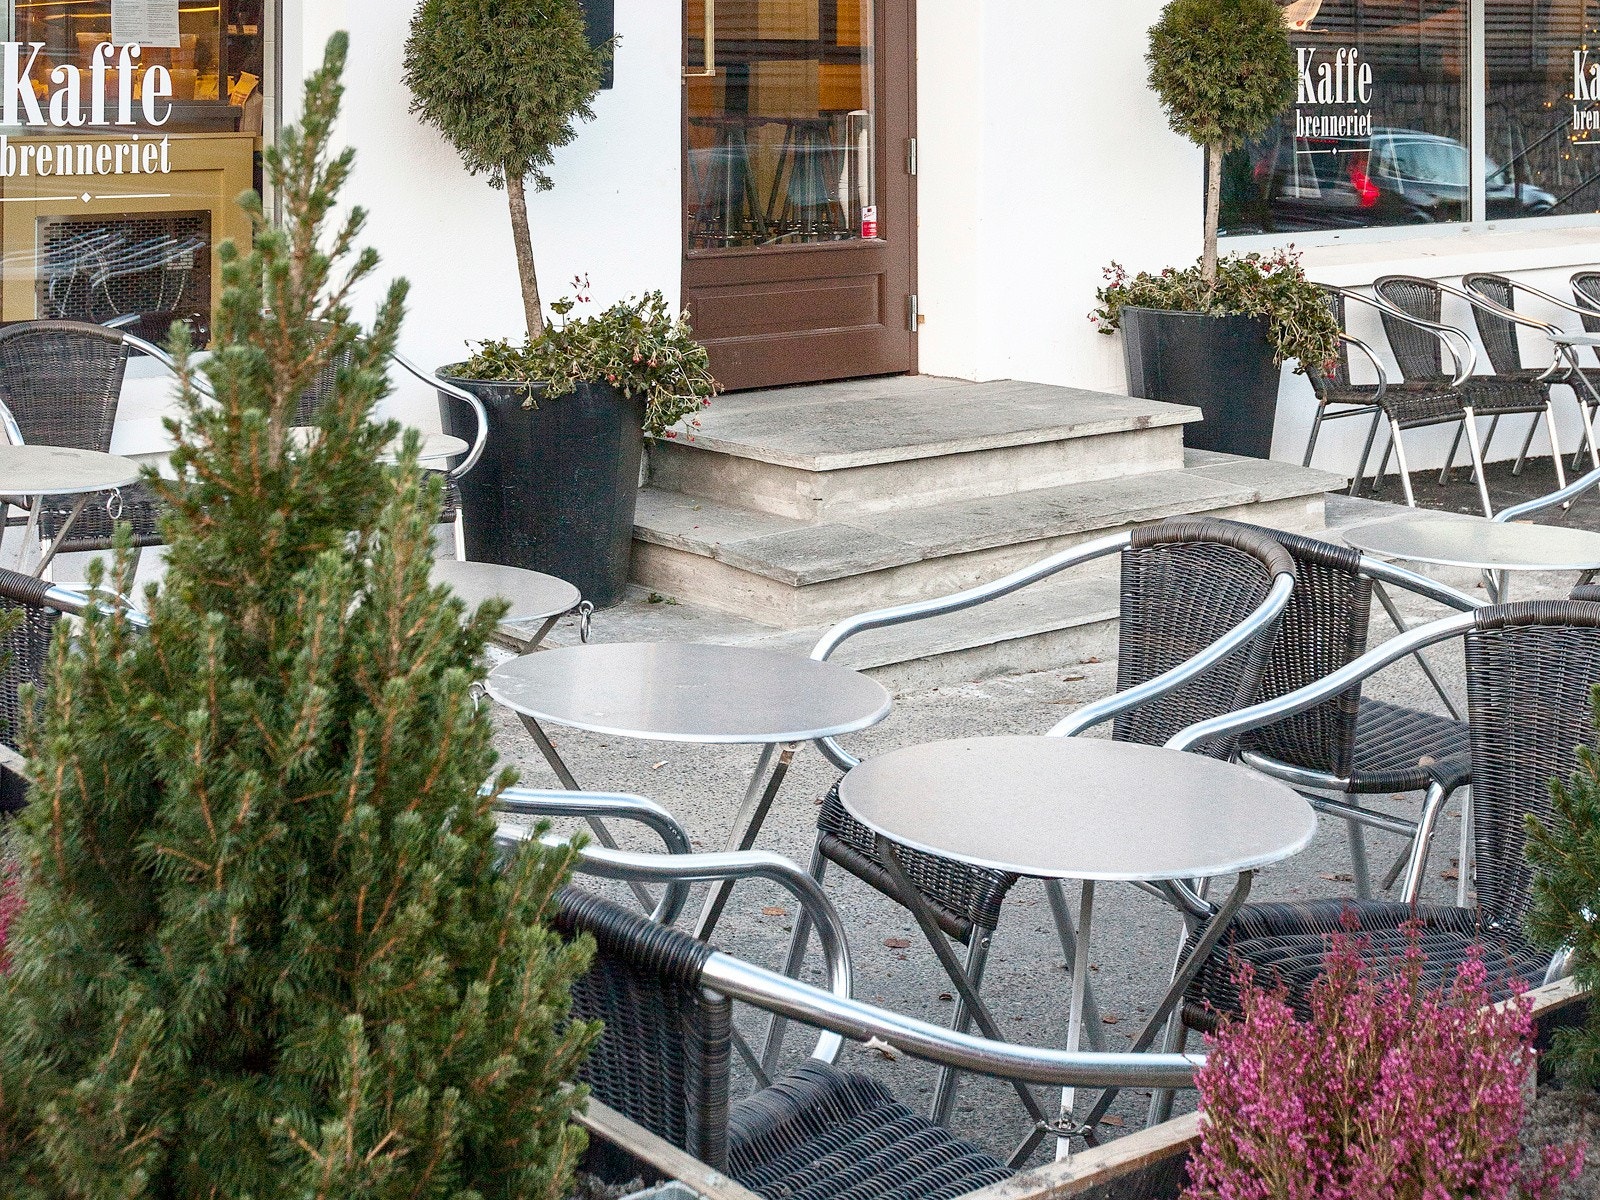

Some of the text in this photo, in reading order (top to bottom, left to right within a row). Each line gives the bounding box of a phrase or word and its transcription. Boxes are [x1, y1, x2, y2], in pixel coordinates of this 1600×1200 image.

[0, 41, 173, 127] Kaffe
[1295, 47, 1373, 105] Kaffe
[1295, 108, 1373, 138] brenneriet
[0, 133, 172, 177] brenneriet
